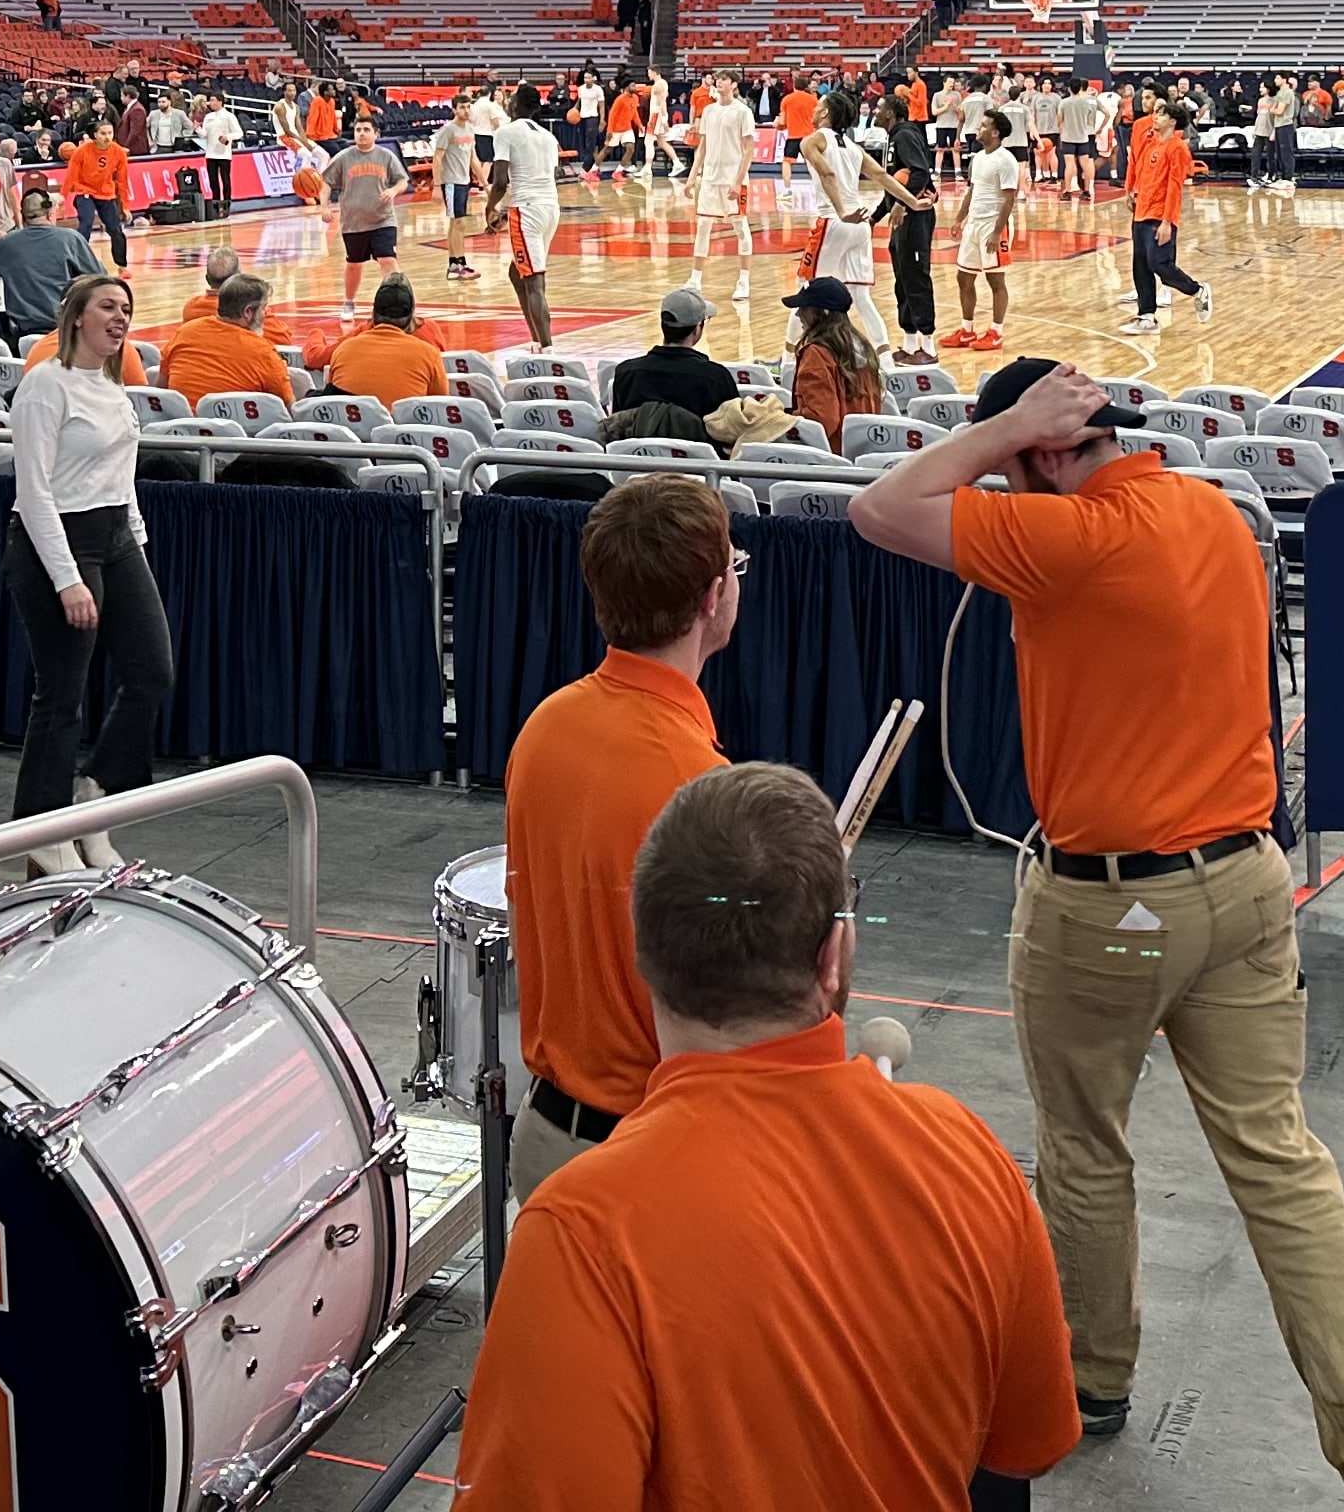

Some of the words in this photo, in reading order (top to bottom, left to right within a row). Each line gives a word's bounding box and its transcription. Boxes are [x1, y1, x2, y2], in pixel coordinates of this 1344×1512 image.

[263, 150, 296, 177] NYE
[432, 436, 450, 458] S
[1276, 447, 1294, 468] S
